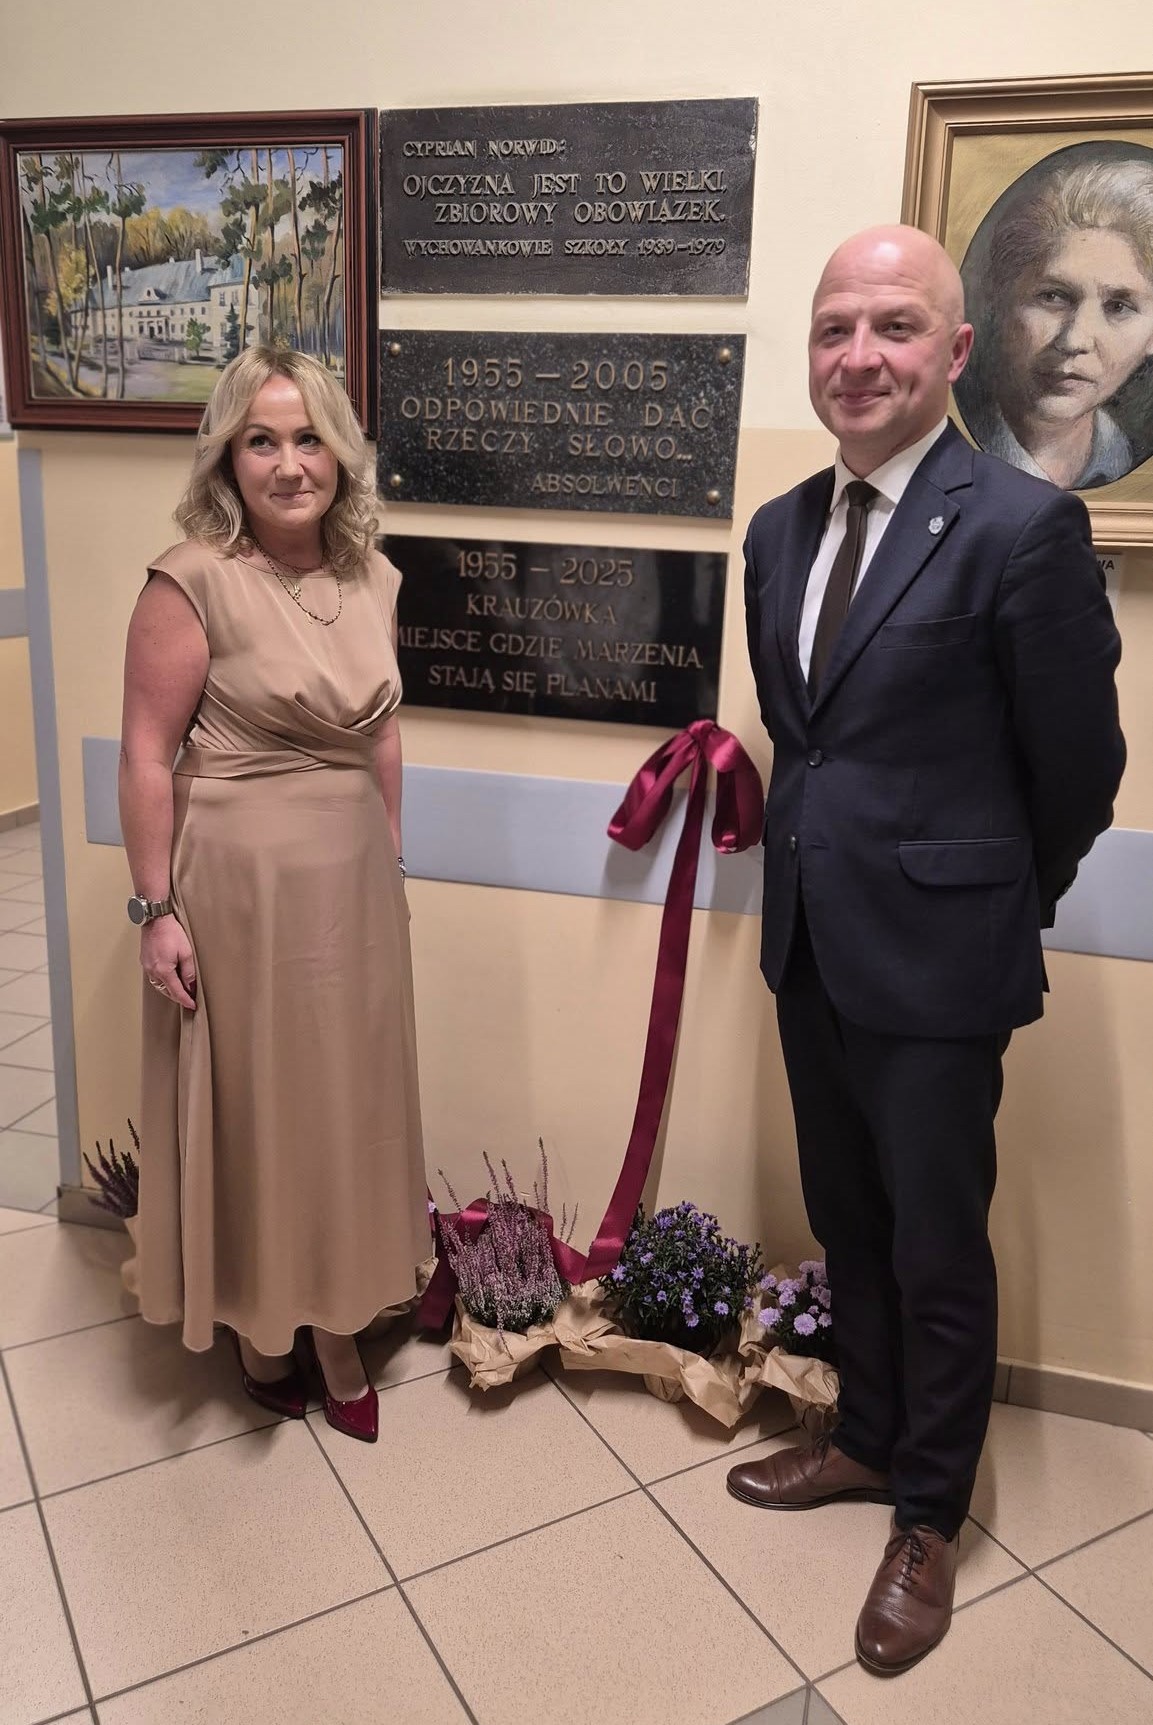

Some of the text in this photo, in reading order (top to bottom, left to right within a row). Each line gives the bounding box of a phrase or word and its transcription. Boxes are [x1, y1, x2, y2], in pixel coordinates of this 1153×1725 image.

[403, 139, 476, 157] CYPRIAN
[403, 173, 515, 199] OJCZYZNA
[531, 172, 580, 200] JEST
[595, 171, 627, 195] TO
[434, 202, 557, 225] ZBIOROWY
[403, 238, 552, 256] WYCHOWANKOWIE
[564, 239, 629, 256] SZKOŁY
[443, 358, 523, 388] 1955
[570, 360, 668, 392] 2005
[401, 397, 613, 426] ODPOWIEDNIE
[427, 428, 534, 454] RZECZY
[531, 473, 679, 499] ABSOLWENCI
[457, 550, 518, 581] 1955
[560, 557, 634, 588] 2025
[466, 593, 618, 626] KRAUZÓWKA
[489, 633, 563, 659] GDZIE
[573, 639, 704, 669] MARZENIA
[428, 664, 657, 702] STAJĄ SIĘ PLANAMI
